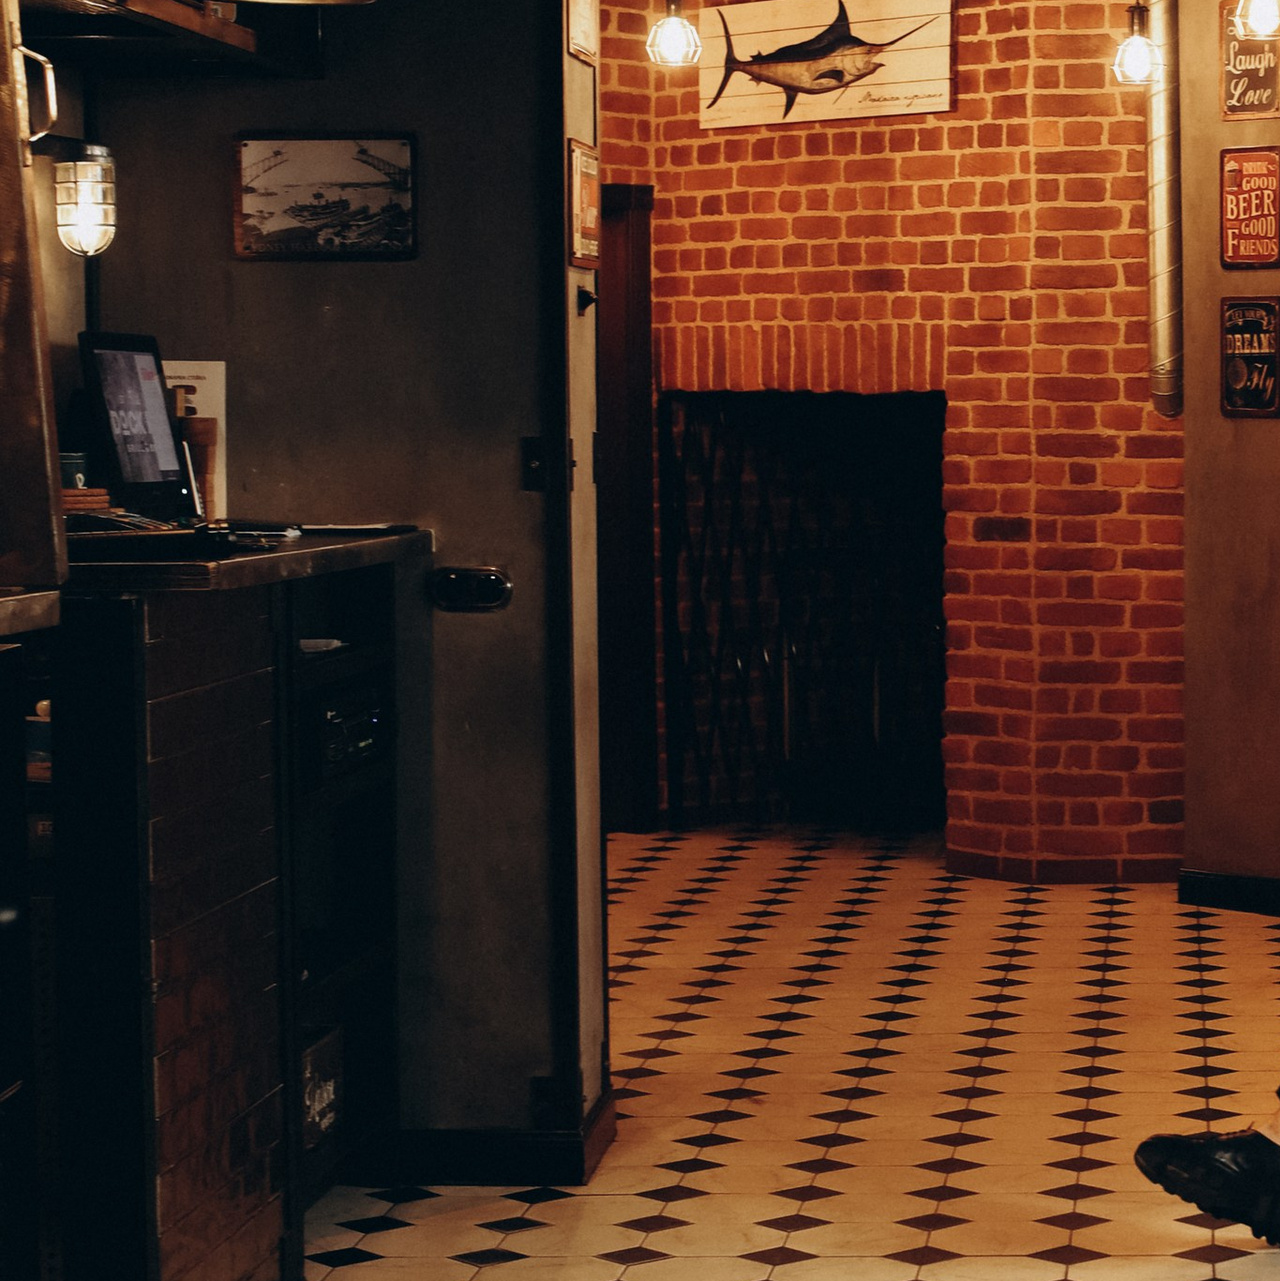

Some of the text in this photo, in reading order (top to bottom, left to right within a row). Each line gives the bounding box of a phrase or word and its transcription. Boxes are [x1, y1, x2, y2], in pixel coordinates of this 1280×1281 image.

[1225, 41, 1277, 77] Laugh
[1227, 77, 1272, 106] Love
[1242, 176, 1277, 191] GOOD
[1225, 189, 1277, 220] BEER
[1241, 216, 1276, 238] GOOD
[1226, 229, 1278, 257] FRIENDS
[1225, 333, 1276, 354] DREAMS
